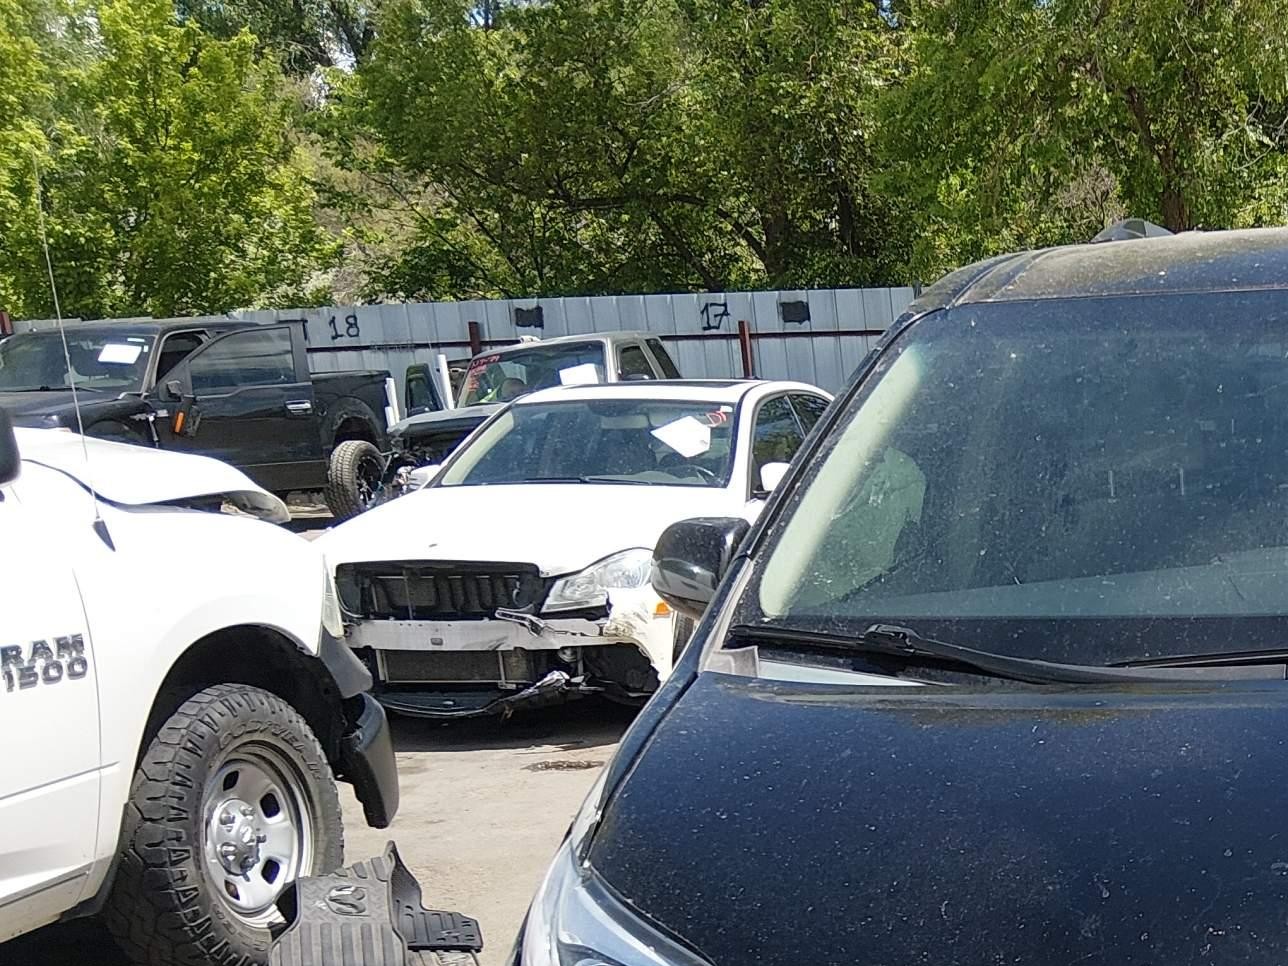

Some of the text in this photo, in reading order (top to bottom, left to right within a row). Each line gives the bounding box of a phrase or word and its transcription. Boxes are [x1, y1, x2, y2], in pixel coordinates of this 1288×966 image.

[328, 314, 361, 340] 18
[700, 302, 731, 331] 17
[0, 633, 85, 670] RAM
[3, 655, 88, 693] 1500
